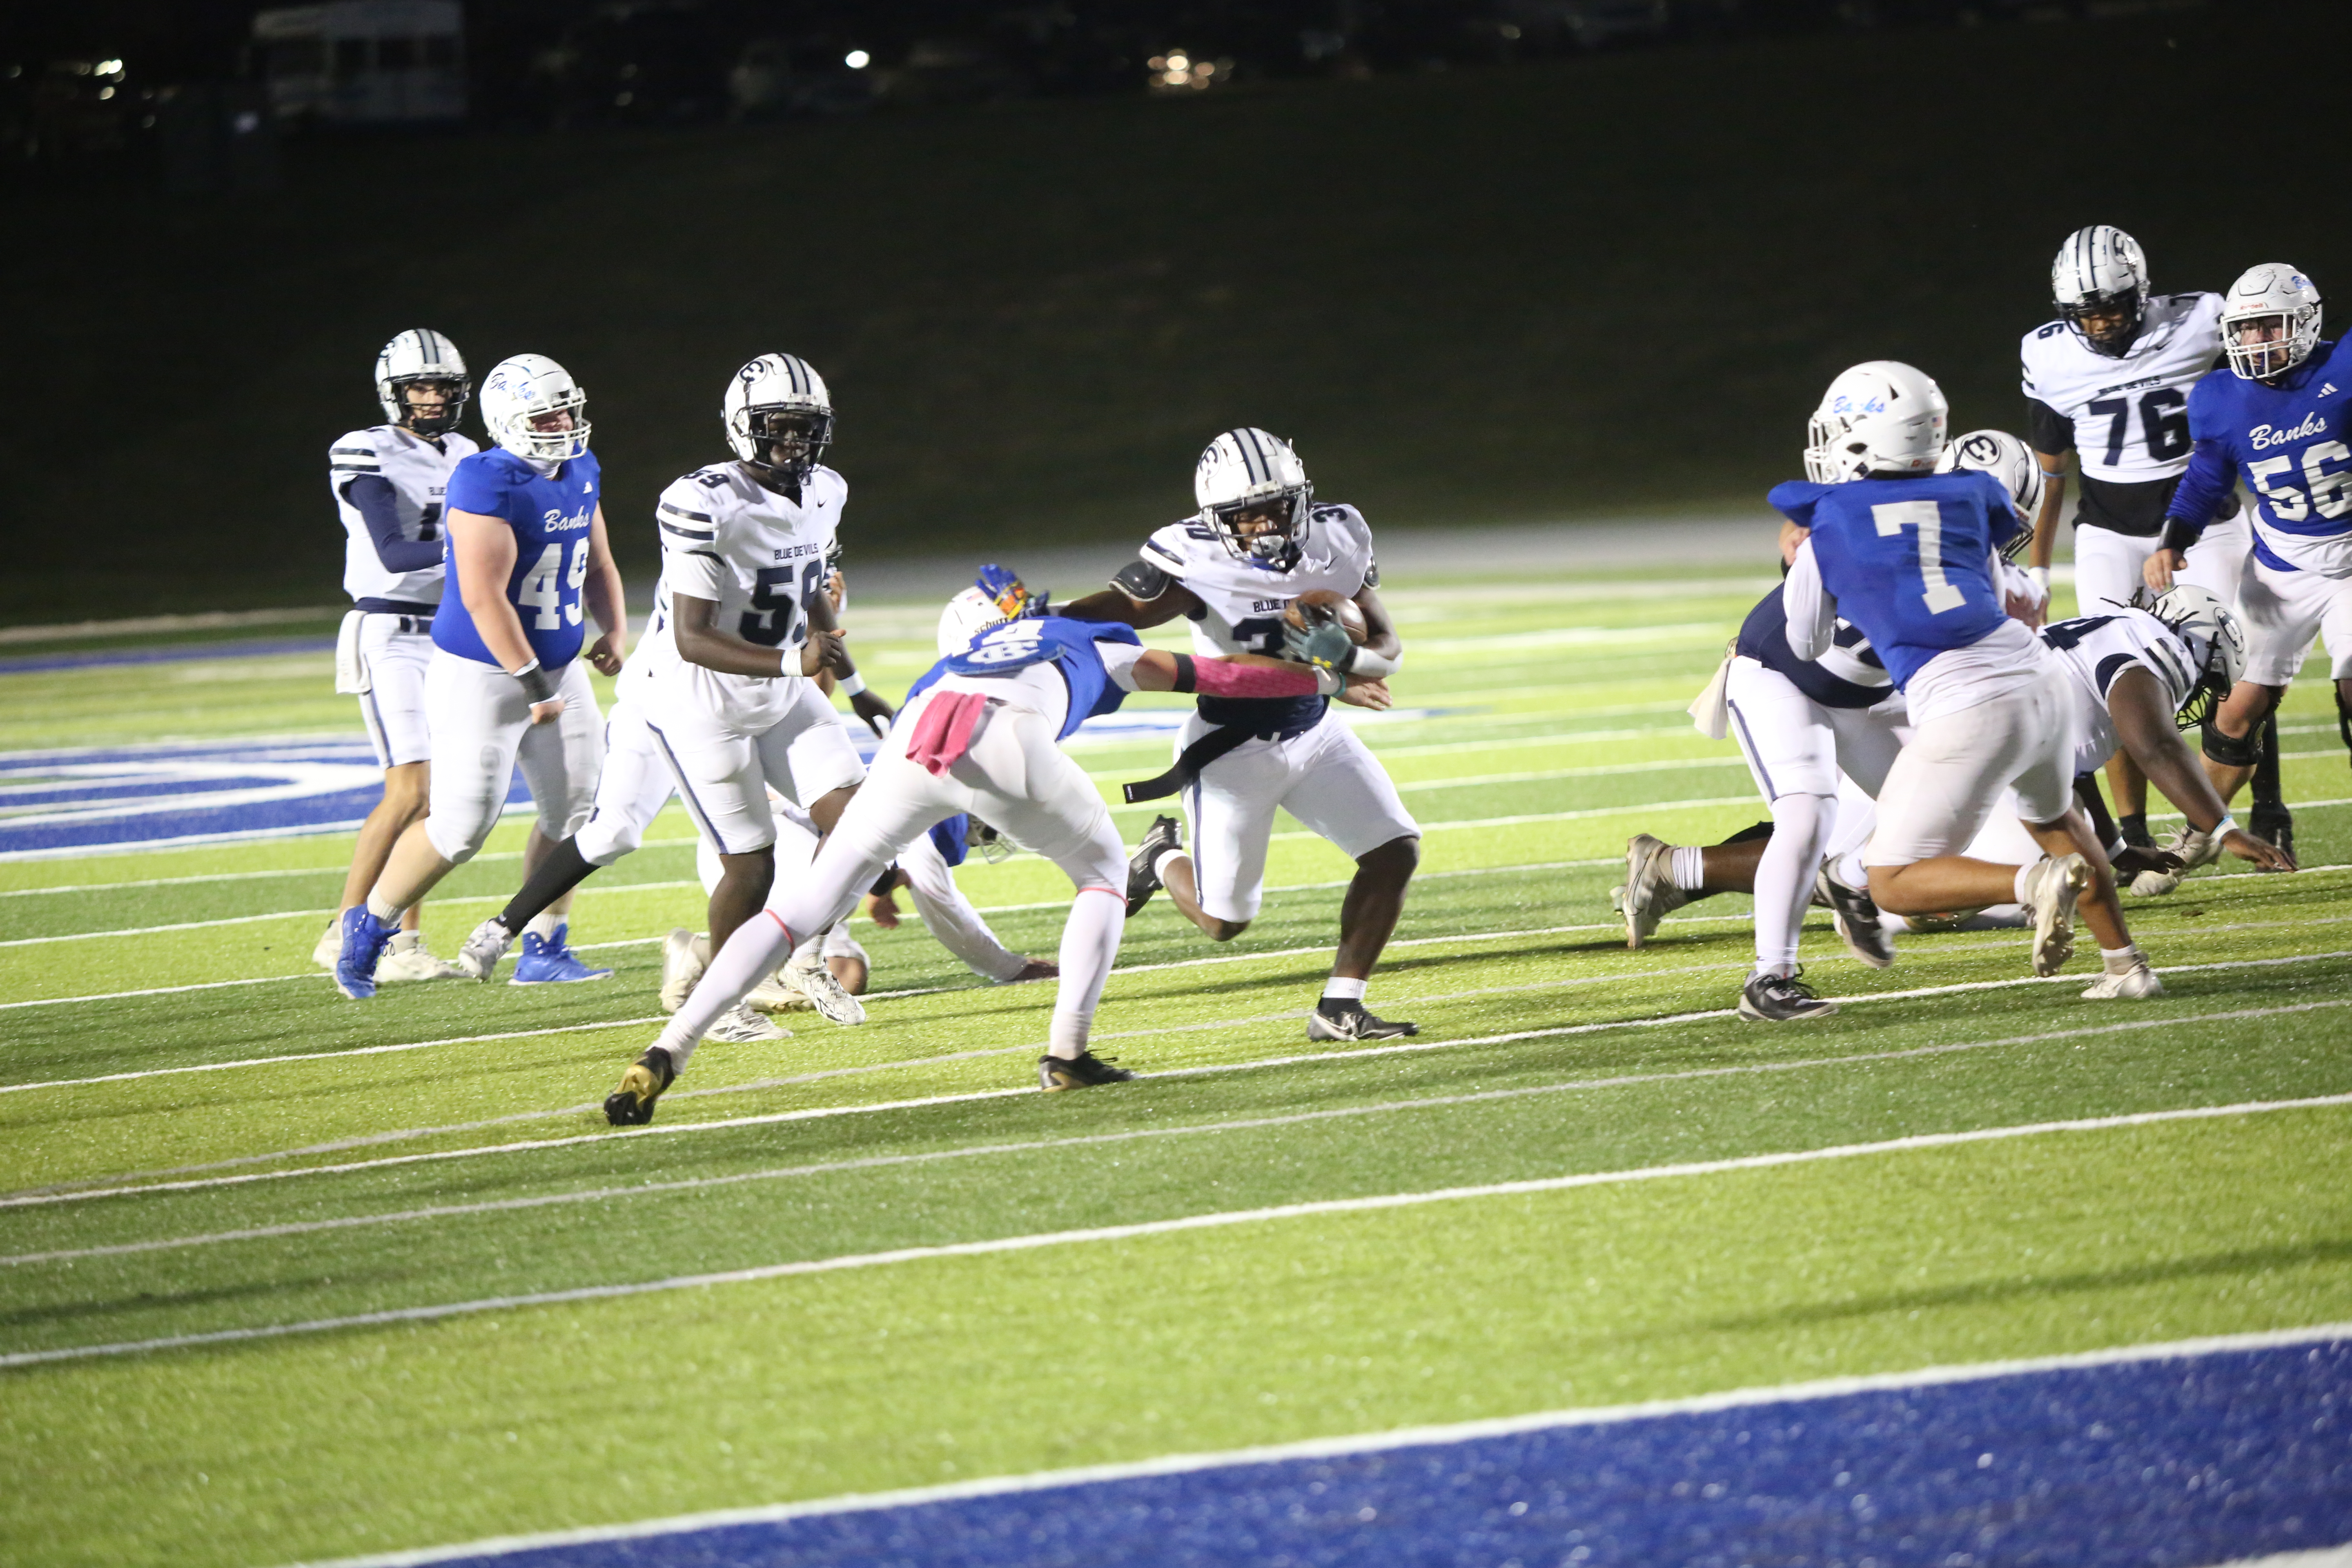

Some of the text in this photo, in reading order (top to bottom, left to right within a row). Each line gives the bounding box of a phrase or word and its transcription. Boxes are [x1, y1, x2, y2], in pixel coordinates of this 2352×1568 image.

[1833, 395, 1885, 414] Baks
[2087, 388, 2192, 466] 76
[2248, 411, 2328, 450] Banks
[2246, 440, 2352, 521] 56
[543, 505, 590, 533] Banks
[774, 542, 819, 560] BLUE DEVILS
[1870, 500, 1967, 615] 7
[518, 536, 590, 630] 49
[739, 558, 823, 647] 59
[1253, 599, 1281, 612] BLUE
[1232, 617, 1286, 661] 3
